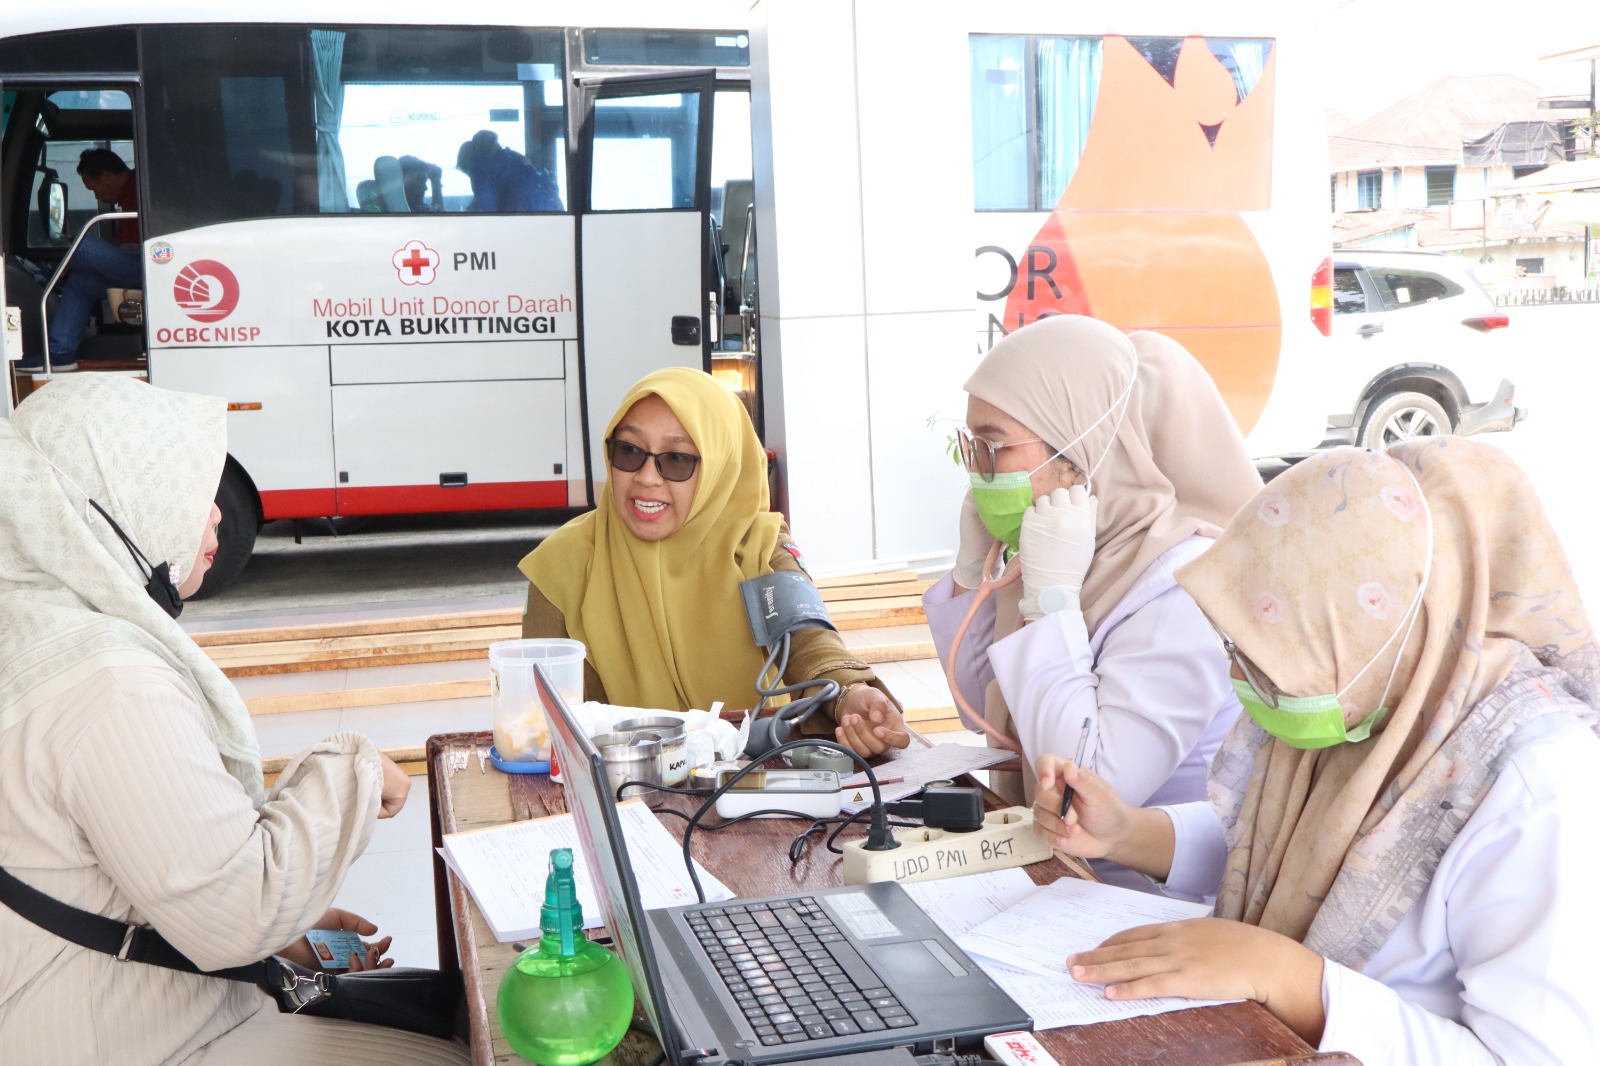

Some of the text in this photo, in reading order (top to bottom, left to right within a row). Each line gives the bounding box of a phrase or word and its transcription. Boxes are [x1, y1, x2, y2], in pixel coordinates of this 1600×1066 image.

[453, 251, 496, 271] PMI
[313, 294, 572, 318] Mobil Unit Donor Darah
[156, 326, 261, 343] OCBC NISP
[326, 316, 556, 338] KOTA BUKITTINGGI
[894, 838, 1014, 880] UDD PMI BKT
